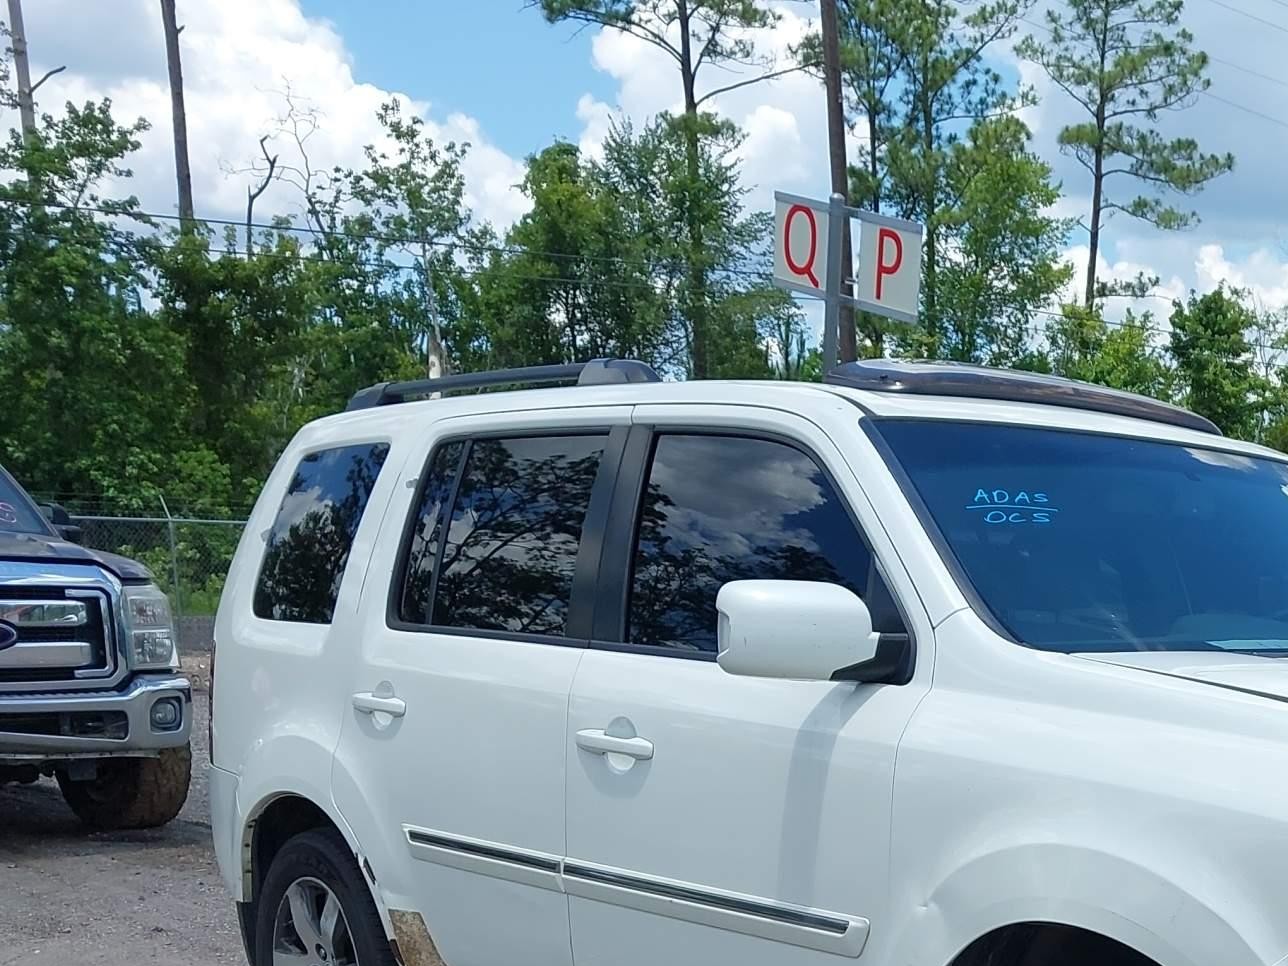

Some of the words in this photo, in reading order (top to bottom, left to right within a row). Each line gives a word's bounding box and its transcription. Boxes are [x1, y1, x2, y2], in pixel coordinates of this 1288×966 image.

[784, 204, 820, 289] Q
[875, 227, 903, 301] P
[974, 488, 1049, 504] ADAS
